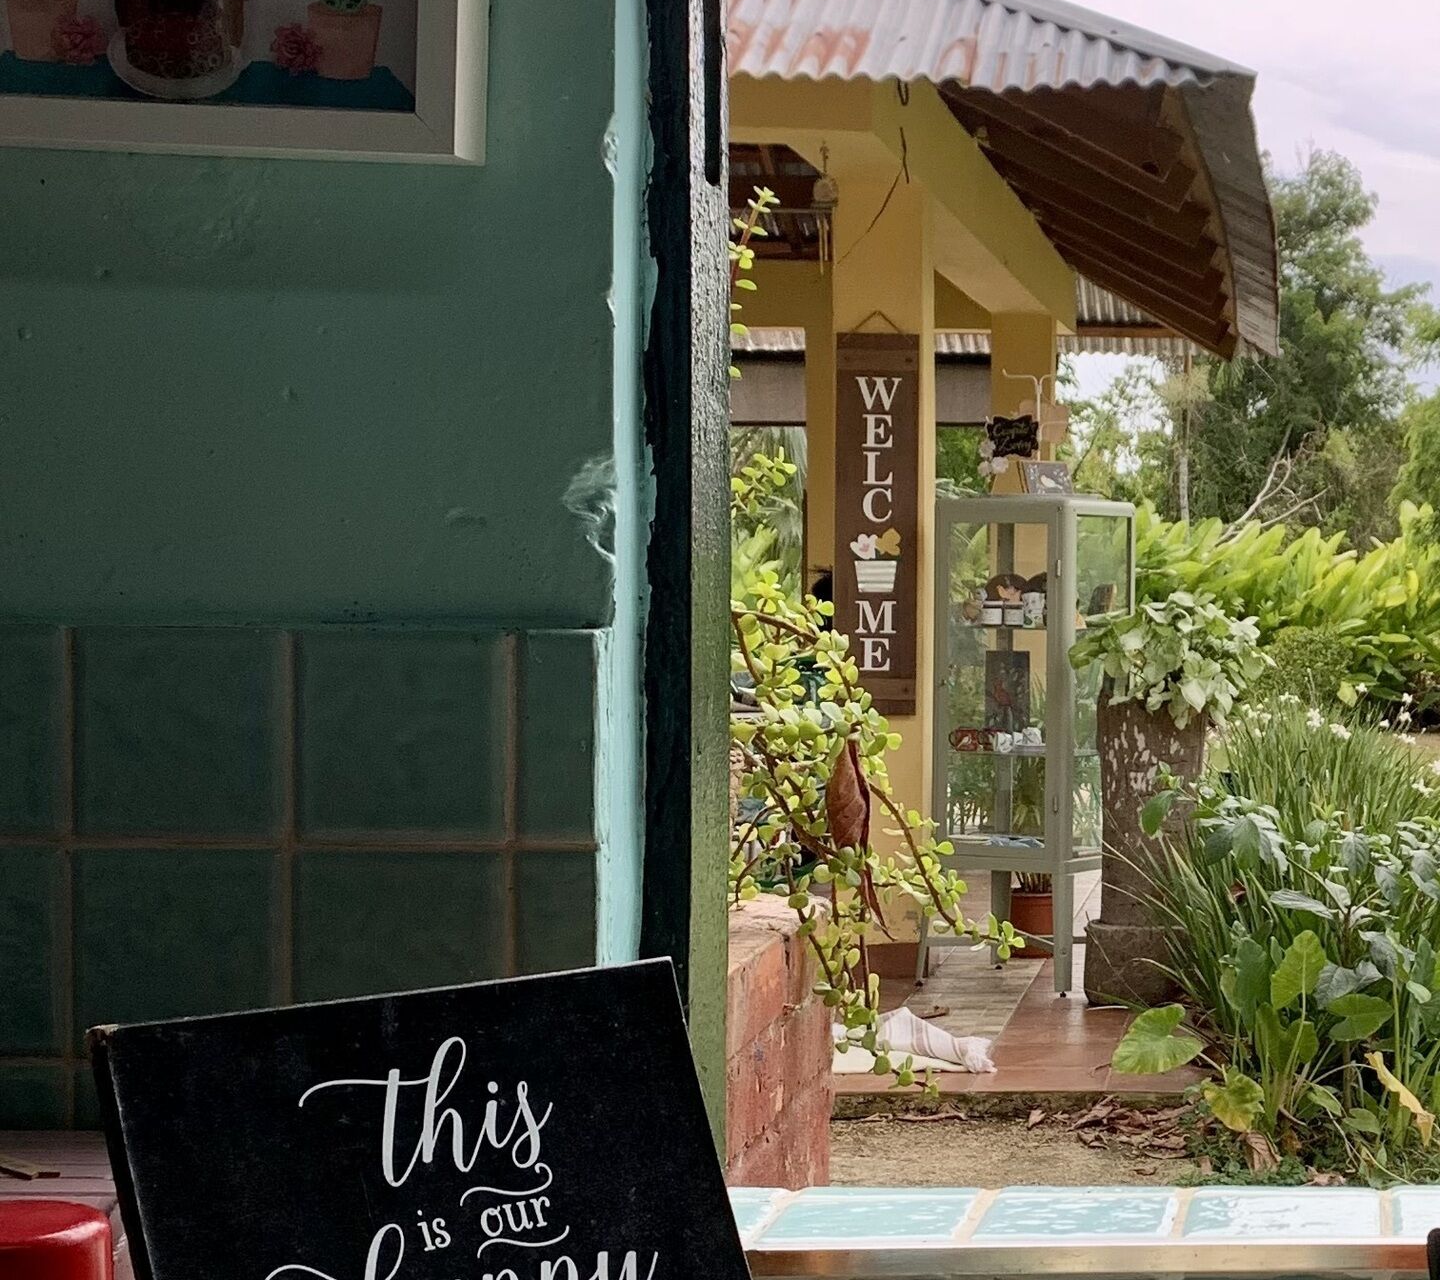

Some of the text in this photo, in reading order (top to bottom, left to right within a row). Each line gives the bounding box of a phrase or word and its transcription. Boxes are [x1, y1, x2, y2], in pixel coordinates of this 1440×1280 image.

[853, 375, 902, 672] WELCME
[298, 1035, 553, 1188] this
[416, 1191, 552, 1253] is our
